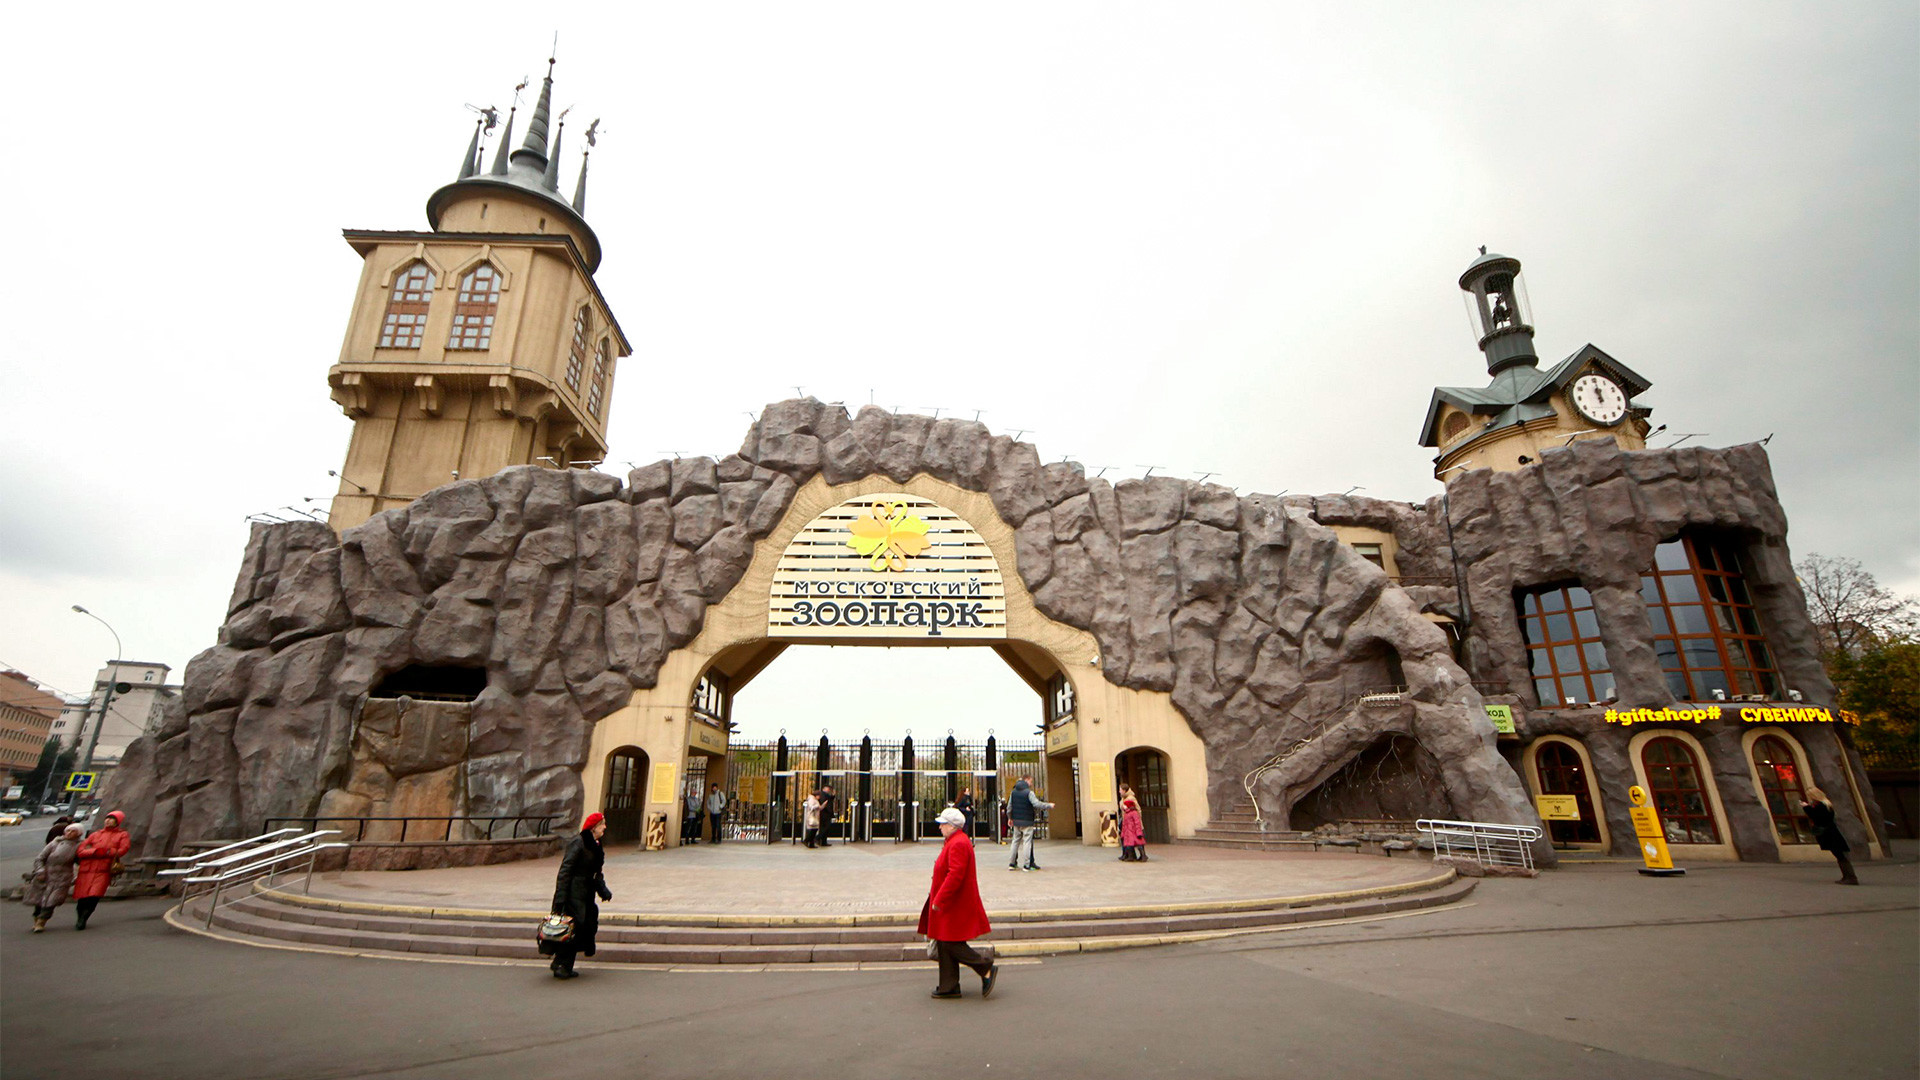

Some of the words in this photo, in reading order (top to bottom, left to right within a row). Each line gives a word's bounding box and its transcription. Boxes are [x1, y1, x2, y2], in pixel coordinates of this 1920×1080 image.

[794, 577, 981, 595] МОСКОВСКИЙ
[791, 601, 984, 636] зоопарк
[1604, 705, 1722, 726] #giftshop#
[1740, 707, 1834, 723] СУВЕНИРЫ
